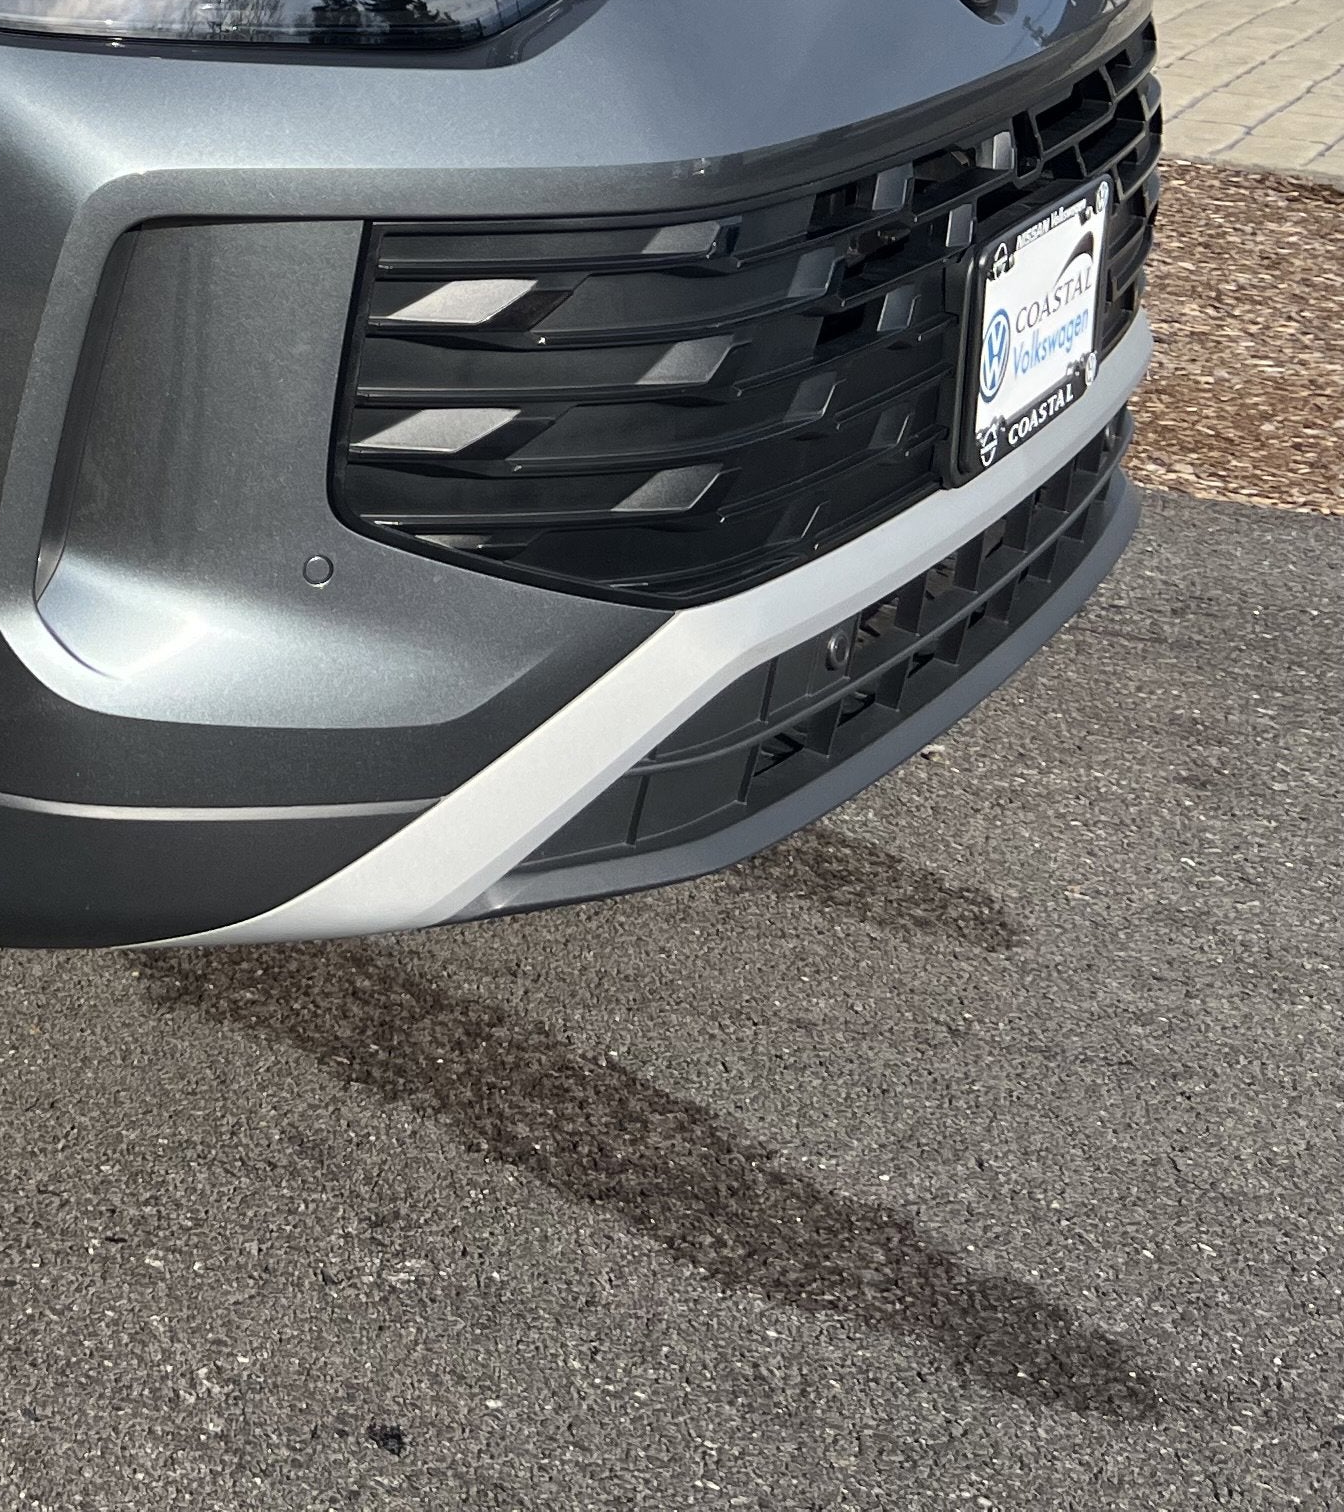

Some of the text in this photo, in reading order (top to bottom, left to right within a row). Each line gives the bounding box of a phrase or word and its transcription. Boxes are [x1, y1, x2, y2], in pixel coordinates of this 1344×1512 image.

[1015, 266, 1092, 334] COASTAL
[1013, 308, 1089, 379] Volkswagen
[1008, 383, 1074, 446] COASTAL
